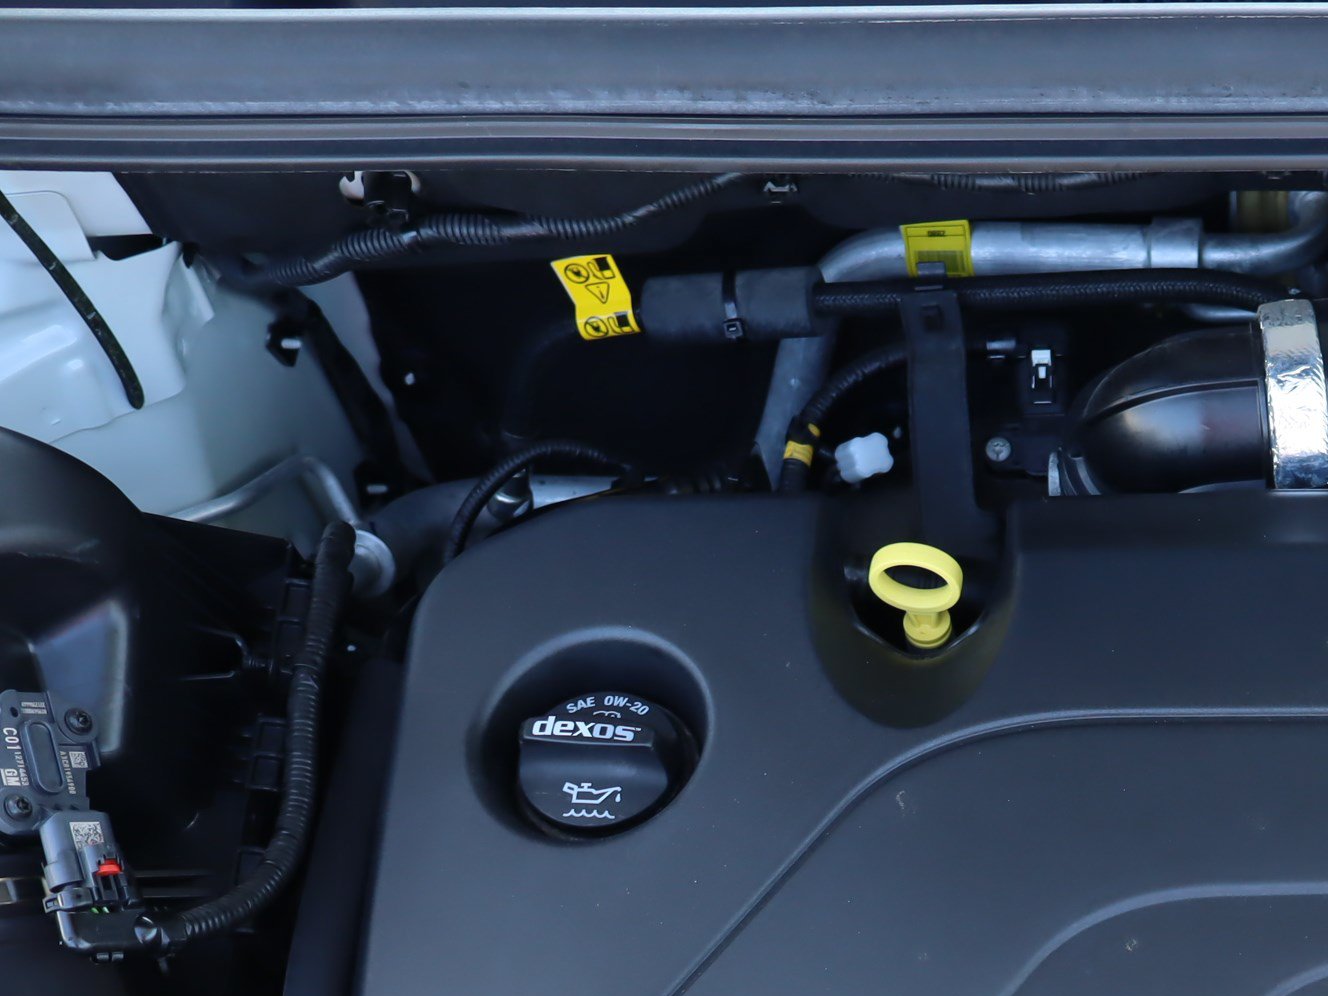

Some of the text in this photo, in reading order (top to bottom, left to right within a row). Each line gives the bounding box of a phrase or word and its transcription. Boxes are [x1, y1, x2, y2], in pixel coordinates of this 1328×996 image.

[566, 695, 649, 716] SAE 0W-20
[4, 768, 22, 786] GM
